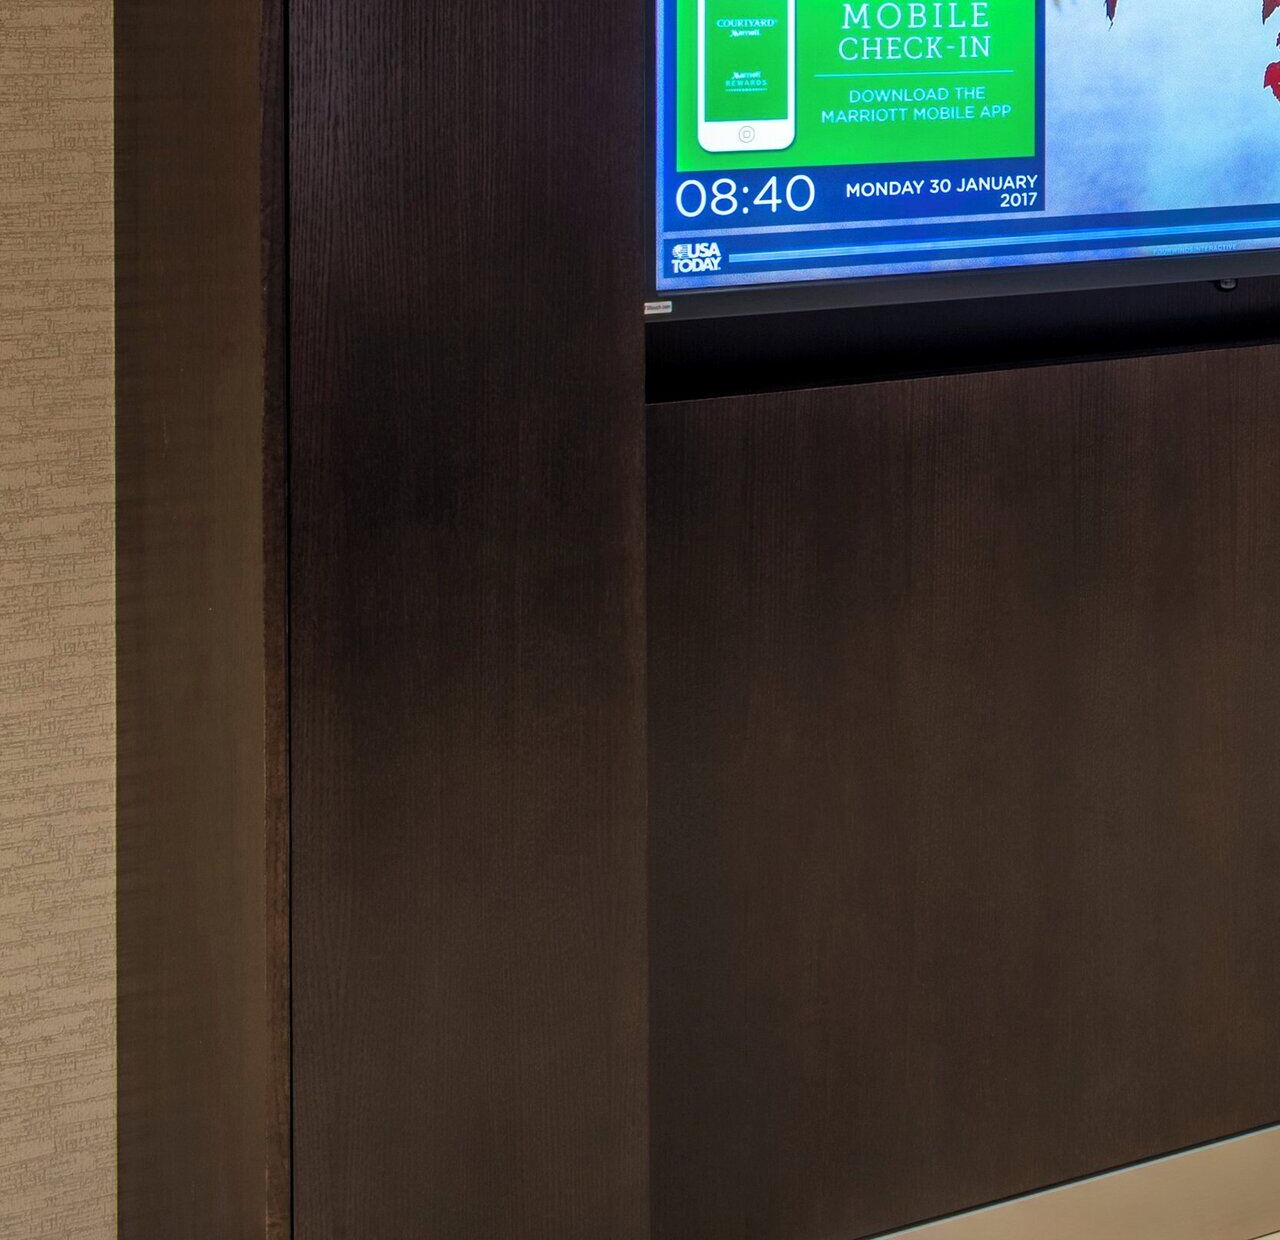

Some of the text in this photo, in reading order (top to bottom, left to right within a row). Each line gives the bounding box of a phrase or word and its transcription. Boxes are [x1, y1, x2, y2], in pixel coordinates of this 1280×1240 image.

[841, 1, 990, 30] MOBILE
[838, 35, 992, 61] CHECK-IN
[849, 86, 986, 104] DOWNLOAD THE
[821, 104, 1012, 124] MARRIOTT MOBILE APP
[675, 174, 816, 218] 08:40
[846, 174, 1038, 198] MONDAY 30 JANUARY
[1000, 191, 1038, 208] 2017
[687, 242, 722, 259] USA
[671, 256, 722, 274] TODAY
